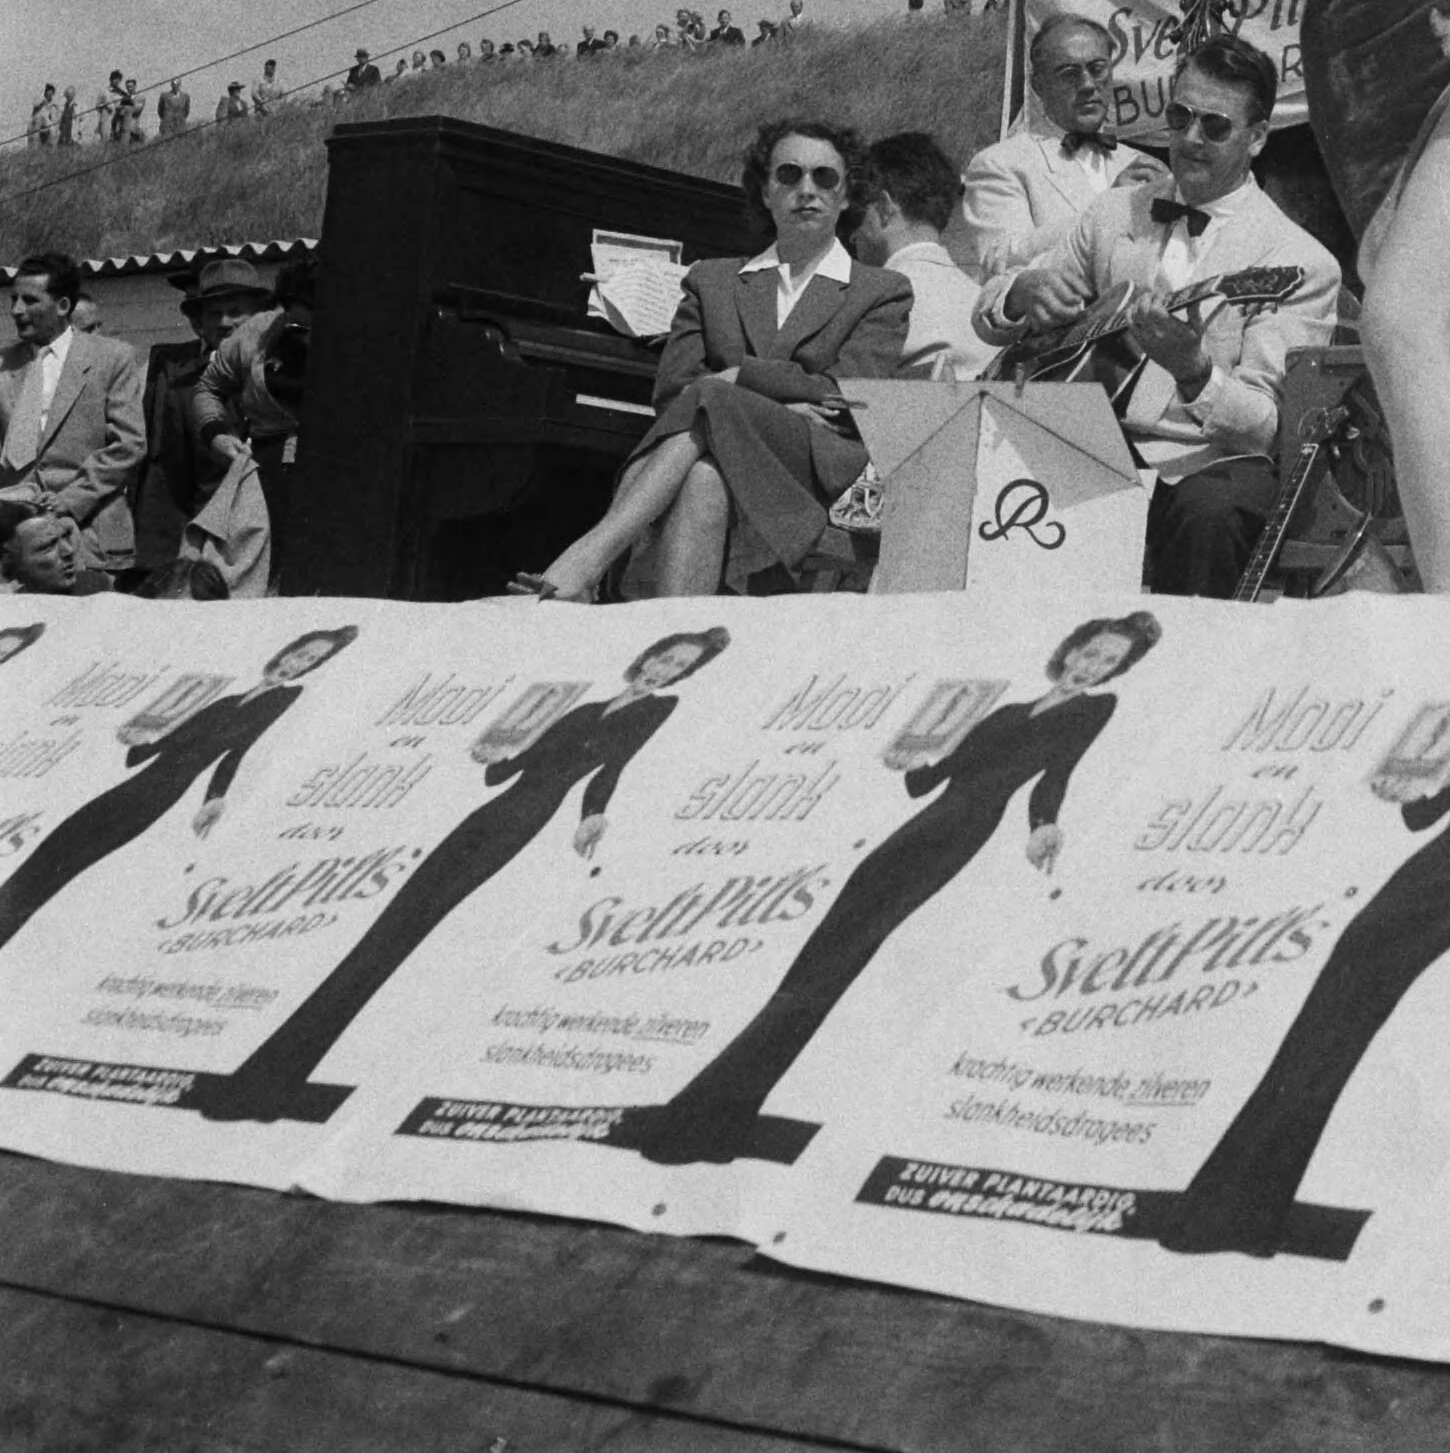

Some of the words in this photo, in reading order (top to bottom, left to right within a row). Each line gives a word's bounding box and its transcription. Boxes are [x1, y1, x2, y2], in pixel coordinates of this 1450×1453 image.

[374, 672, 516, 727] Mooi
[760, 673, 917, 731] Mooi
[1221, 684, 1395, 752] Mooi
[286, 751, 432, 808] slank
[675, 759, 841, 821] slank
[1251, 765, 1300, 780] en
[1135, 785, 1323, 855] slank
[899, 1162, 980, 1189] ZUIVER
